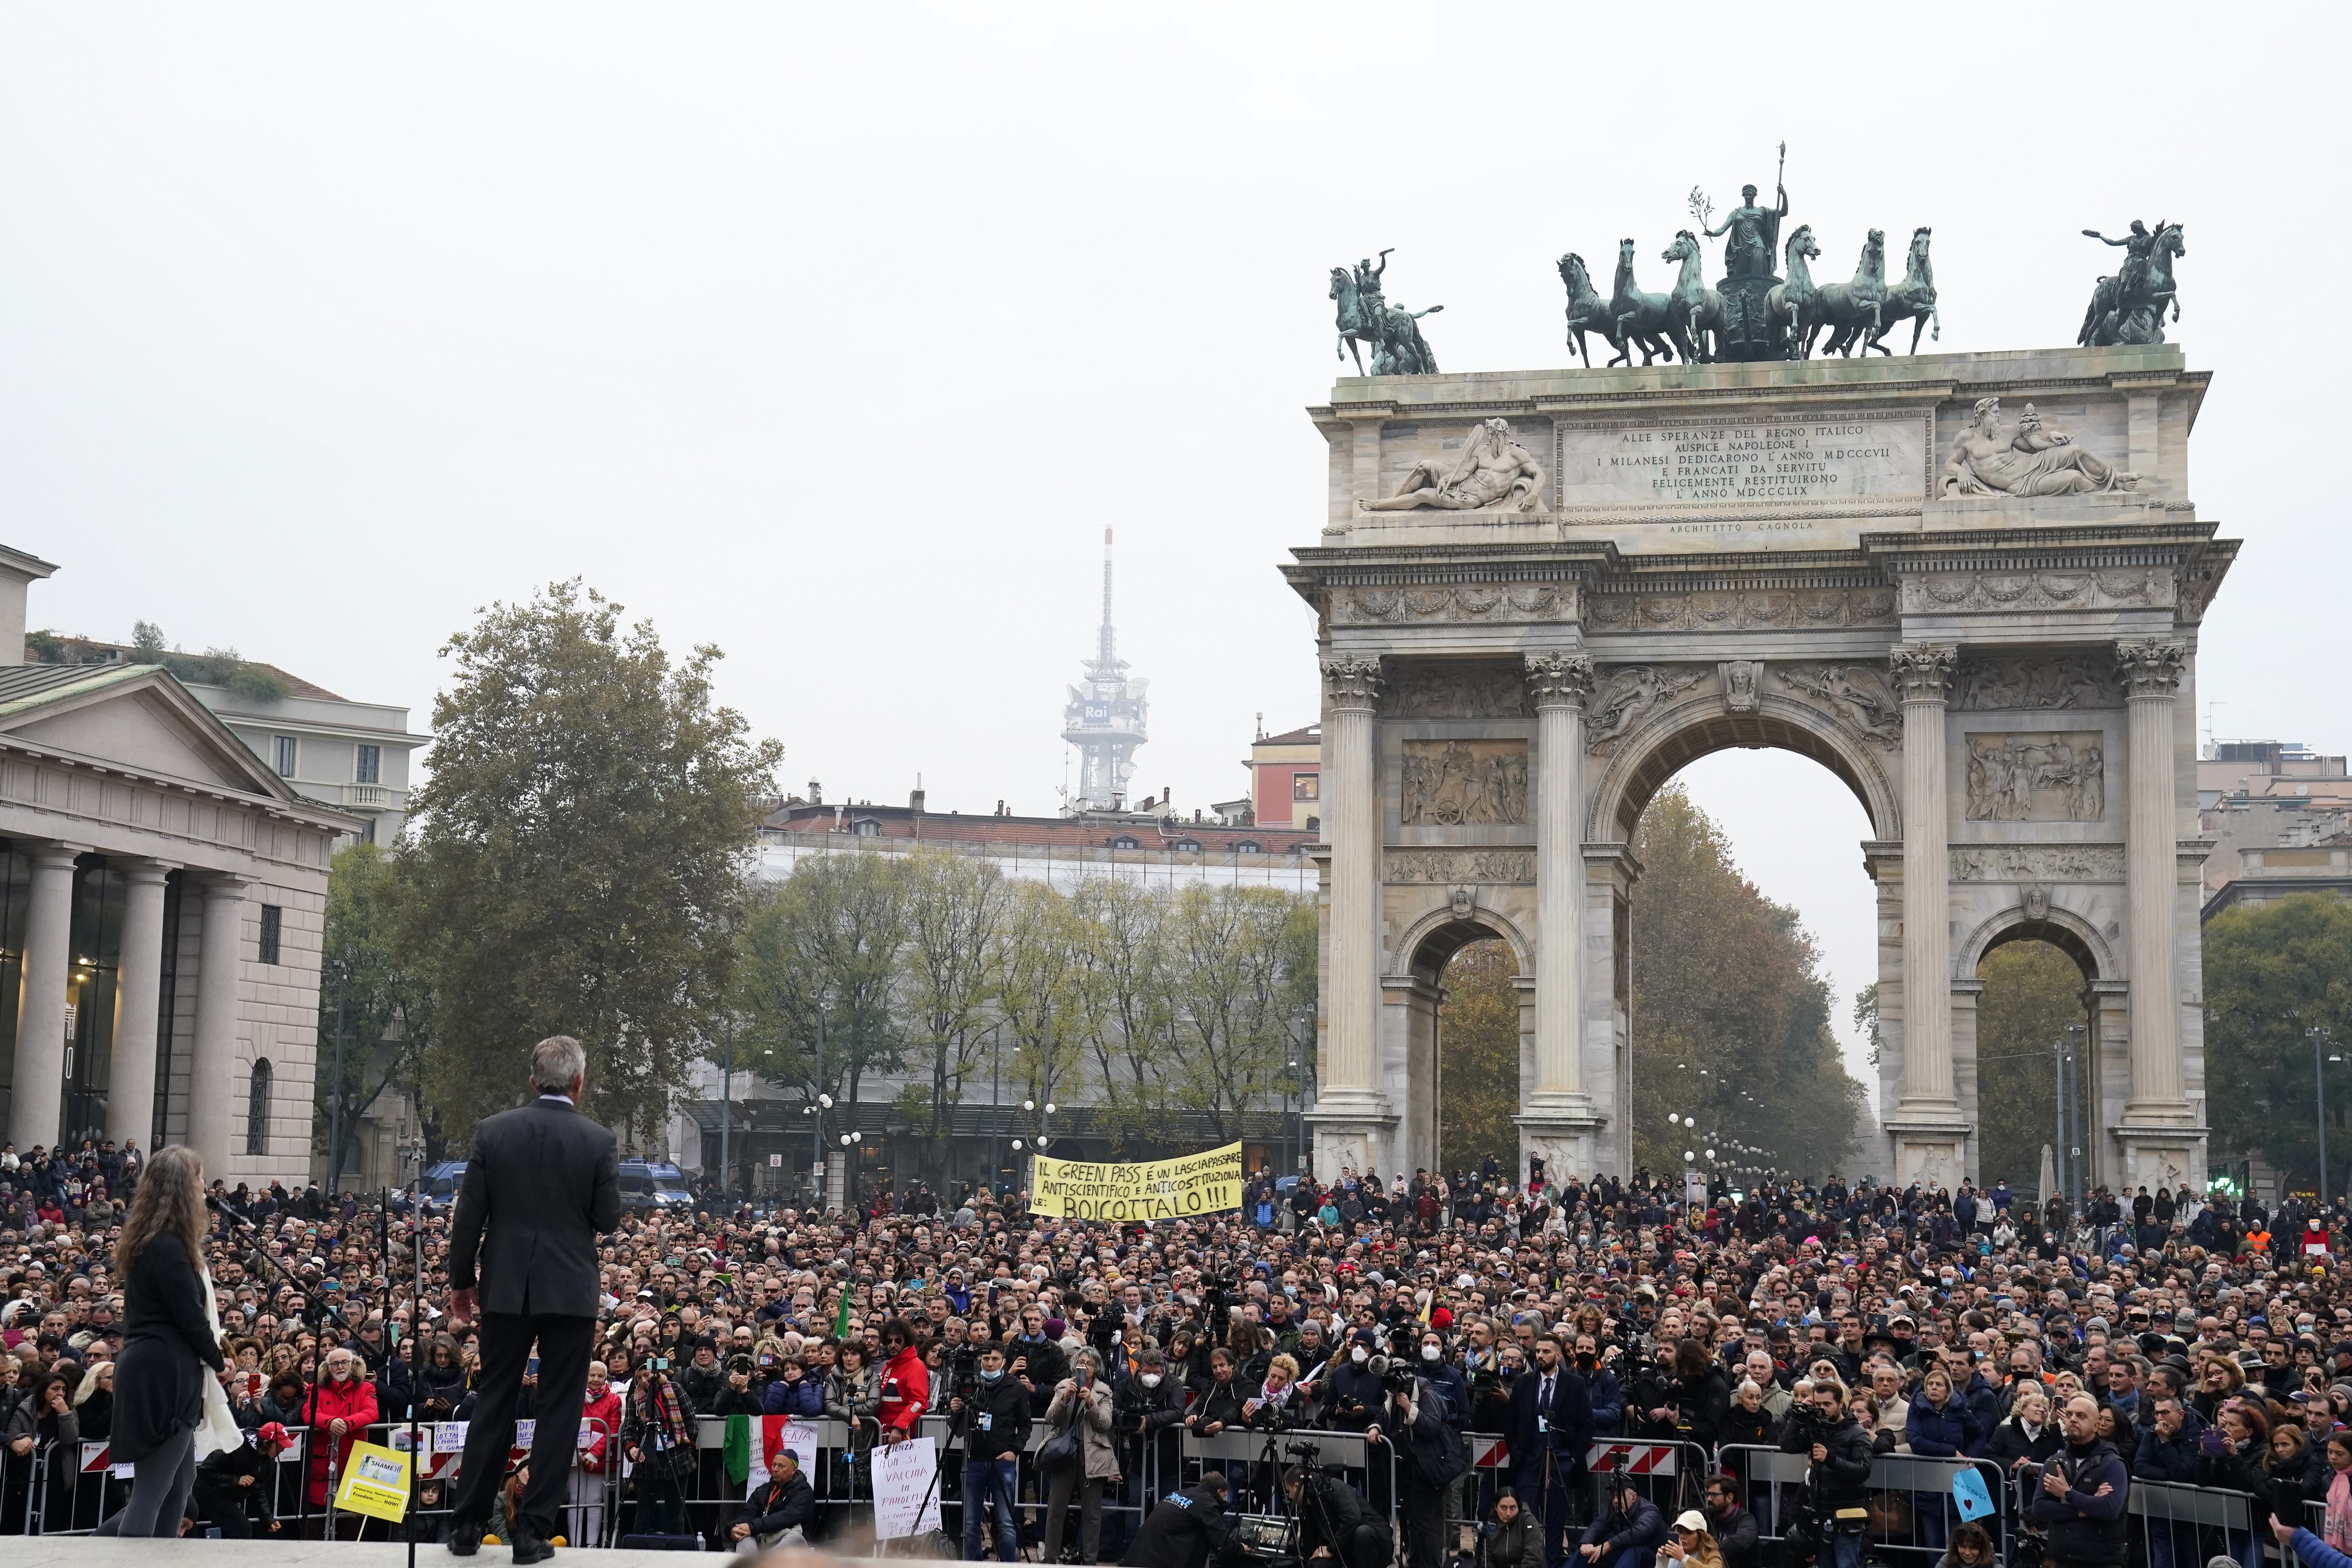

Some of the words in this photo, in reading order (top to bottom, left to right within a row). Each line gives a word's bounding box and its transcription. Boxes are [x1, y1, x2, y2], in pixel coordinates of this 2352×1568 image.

[1622, 433, 1652, 442] ALLE
[1661, 431, 1725, 441] SPERANZE
[1735, 430, 1756, 438] DEL
[1767, 428, 1805, 437] REGNO
[1816, 426, 1863, 436] ITALICO
[1675, 443, 1719, 452] AUSPICE
[1729, 440, 1795, 451] NAPOLEONE
[1805, 440, 1809, 448] I
[1597, 458, 1601, 466] I
[1610, 456, 1669, 466] MILANESI
[1679, 453, 1758, 464] DEDICARONO
[1781, 451, 1814, 460] ANNO
[1825, 449, 1889, 459] MDCCCVII
[1678, 466, 1738, 475] FRANCATI
[1751, 465, 1766, 473] DA
[1777, 463, 1826, 472] SERVITU
[1653, 478, 1734, 488] FELICEMENTE
[1745, 474, 1838, 485] RESTITUIRONO
[1693, 489, 1727, 498] ANNO
[1737, 487, 1807, 497] MDCCCLIX
[1670, 524, 1741, 532] ARCHITETTO
[1759, 522, 1812, 530] CAGNOLA
[1086, 705, 1108, 717] Rai
[1039, 1162, 1050, 1176] IL
[1058, 1164, 1106, 1182] GREEN
[1111, 1166, 1141, 1184] PASS
[1157, 1168, 1170, 1179] UN
[1175, 1151, 1242, 1175] LASCIAPASSARE
[1042, 1180, 1130, 1198] ANTISCIENTIFICO
[781, 1429, 813, 1441] ERTÀ
[371, 1460, 395, 1471] SHAME
[879, 1457, 899, 1469] NON
[906, 1455, 917, 1464] SI
[886, 1467, 927, 1482] VACCINA
[353, 1486, 373, 1494] Democracy,
[901, 1484, 910, 1492] IN
[906, 1517, 938, 1526] CONNUARE
